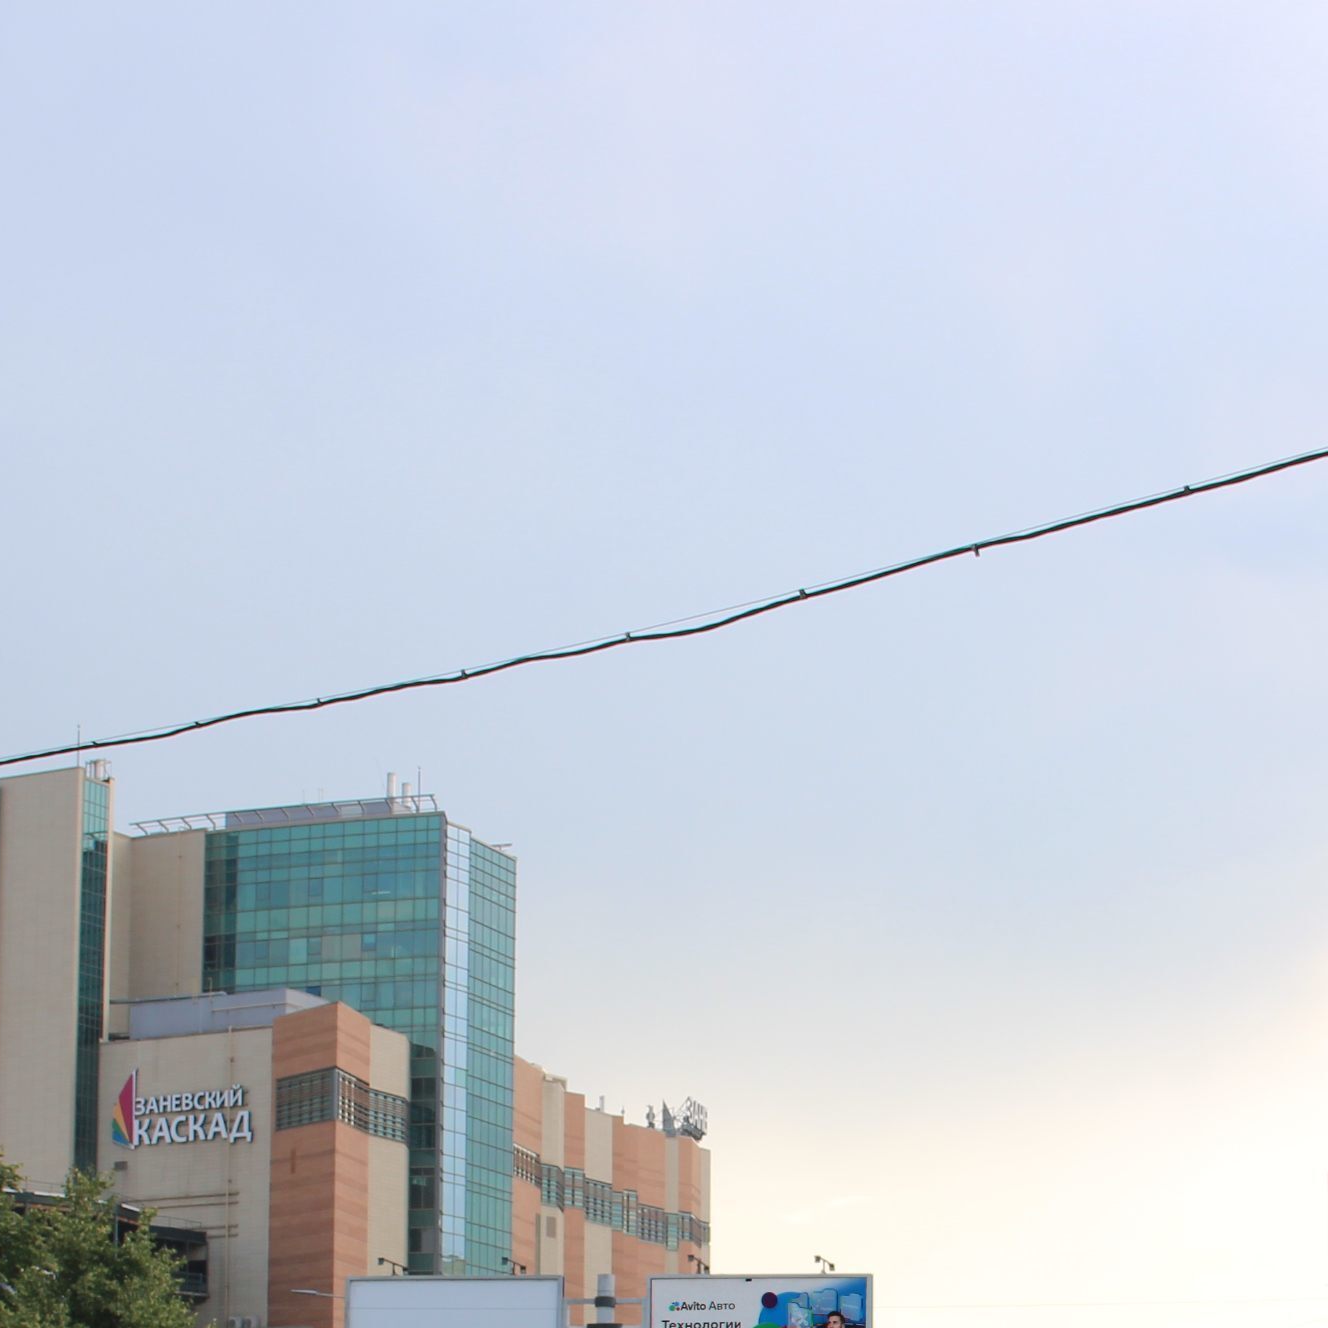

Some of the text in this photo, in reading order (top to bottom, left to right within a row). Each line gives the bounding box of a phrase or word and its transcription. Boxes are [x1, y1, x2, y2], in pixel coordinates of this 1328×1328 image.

[135, 1084, 243, 1115] ЗАНЕВСКИЙ
[133, 1111, 253, 1146] КАСКАД
[681, 1301, 736, 1311] Avito Авто
